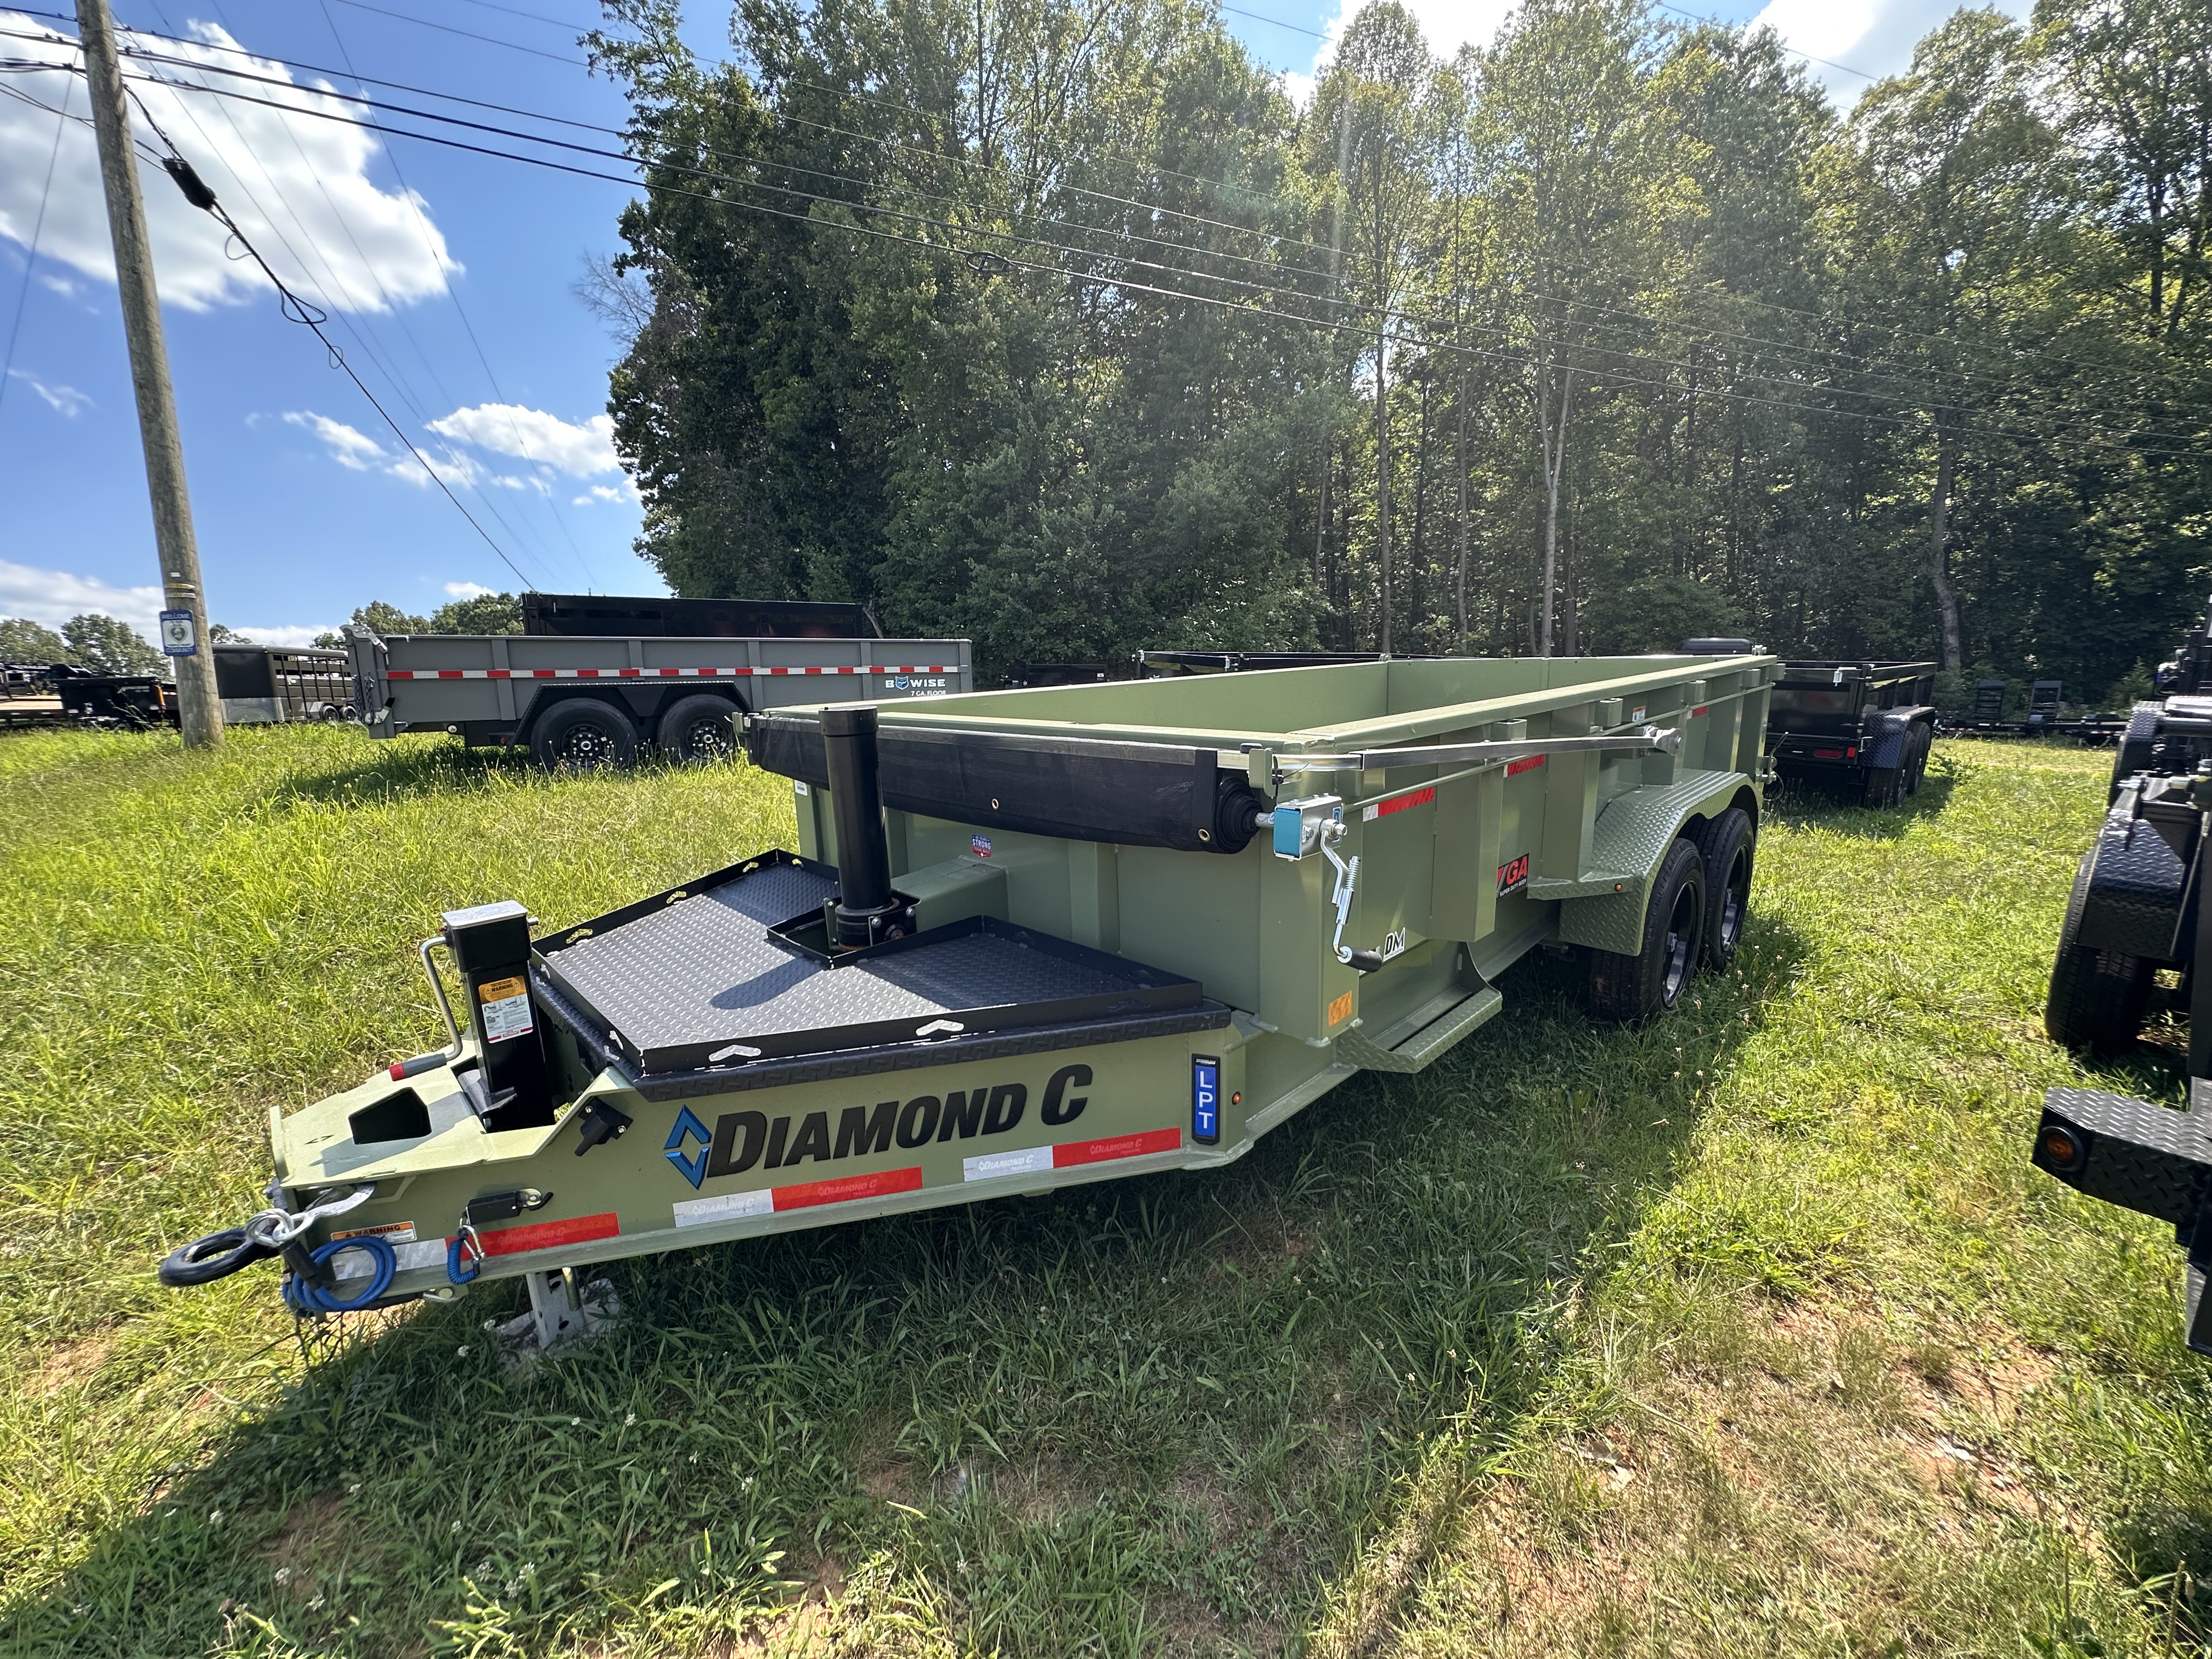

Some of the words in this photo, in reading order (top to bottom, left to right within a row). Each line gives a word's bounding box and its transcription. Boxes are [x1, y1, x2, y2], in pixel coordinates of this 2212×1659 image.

[972, 838, 991, 850] STRONG
[1384, 928, 1405, 956] DM
[491, 983, 514, 992] WARNING
[1198, 1071, 1214, 1130] LPT
[706, 1082, 1028, 1178] DIAMOND
[1040, 1063, 1093, 1126] C
[985, 1158, 1026, 1170] DIAMOND
[1026, 1155, 1034, 1164] C
[825, 1182, 865, 1196] DIAMOND
[868, 1179, 878, 1189] C
[744, 1198, 755, 1209] C
[353, 1224, 400, 1236] WARNING
